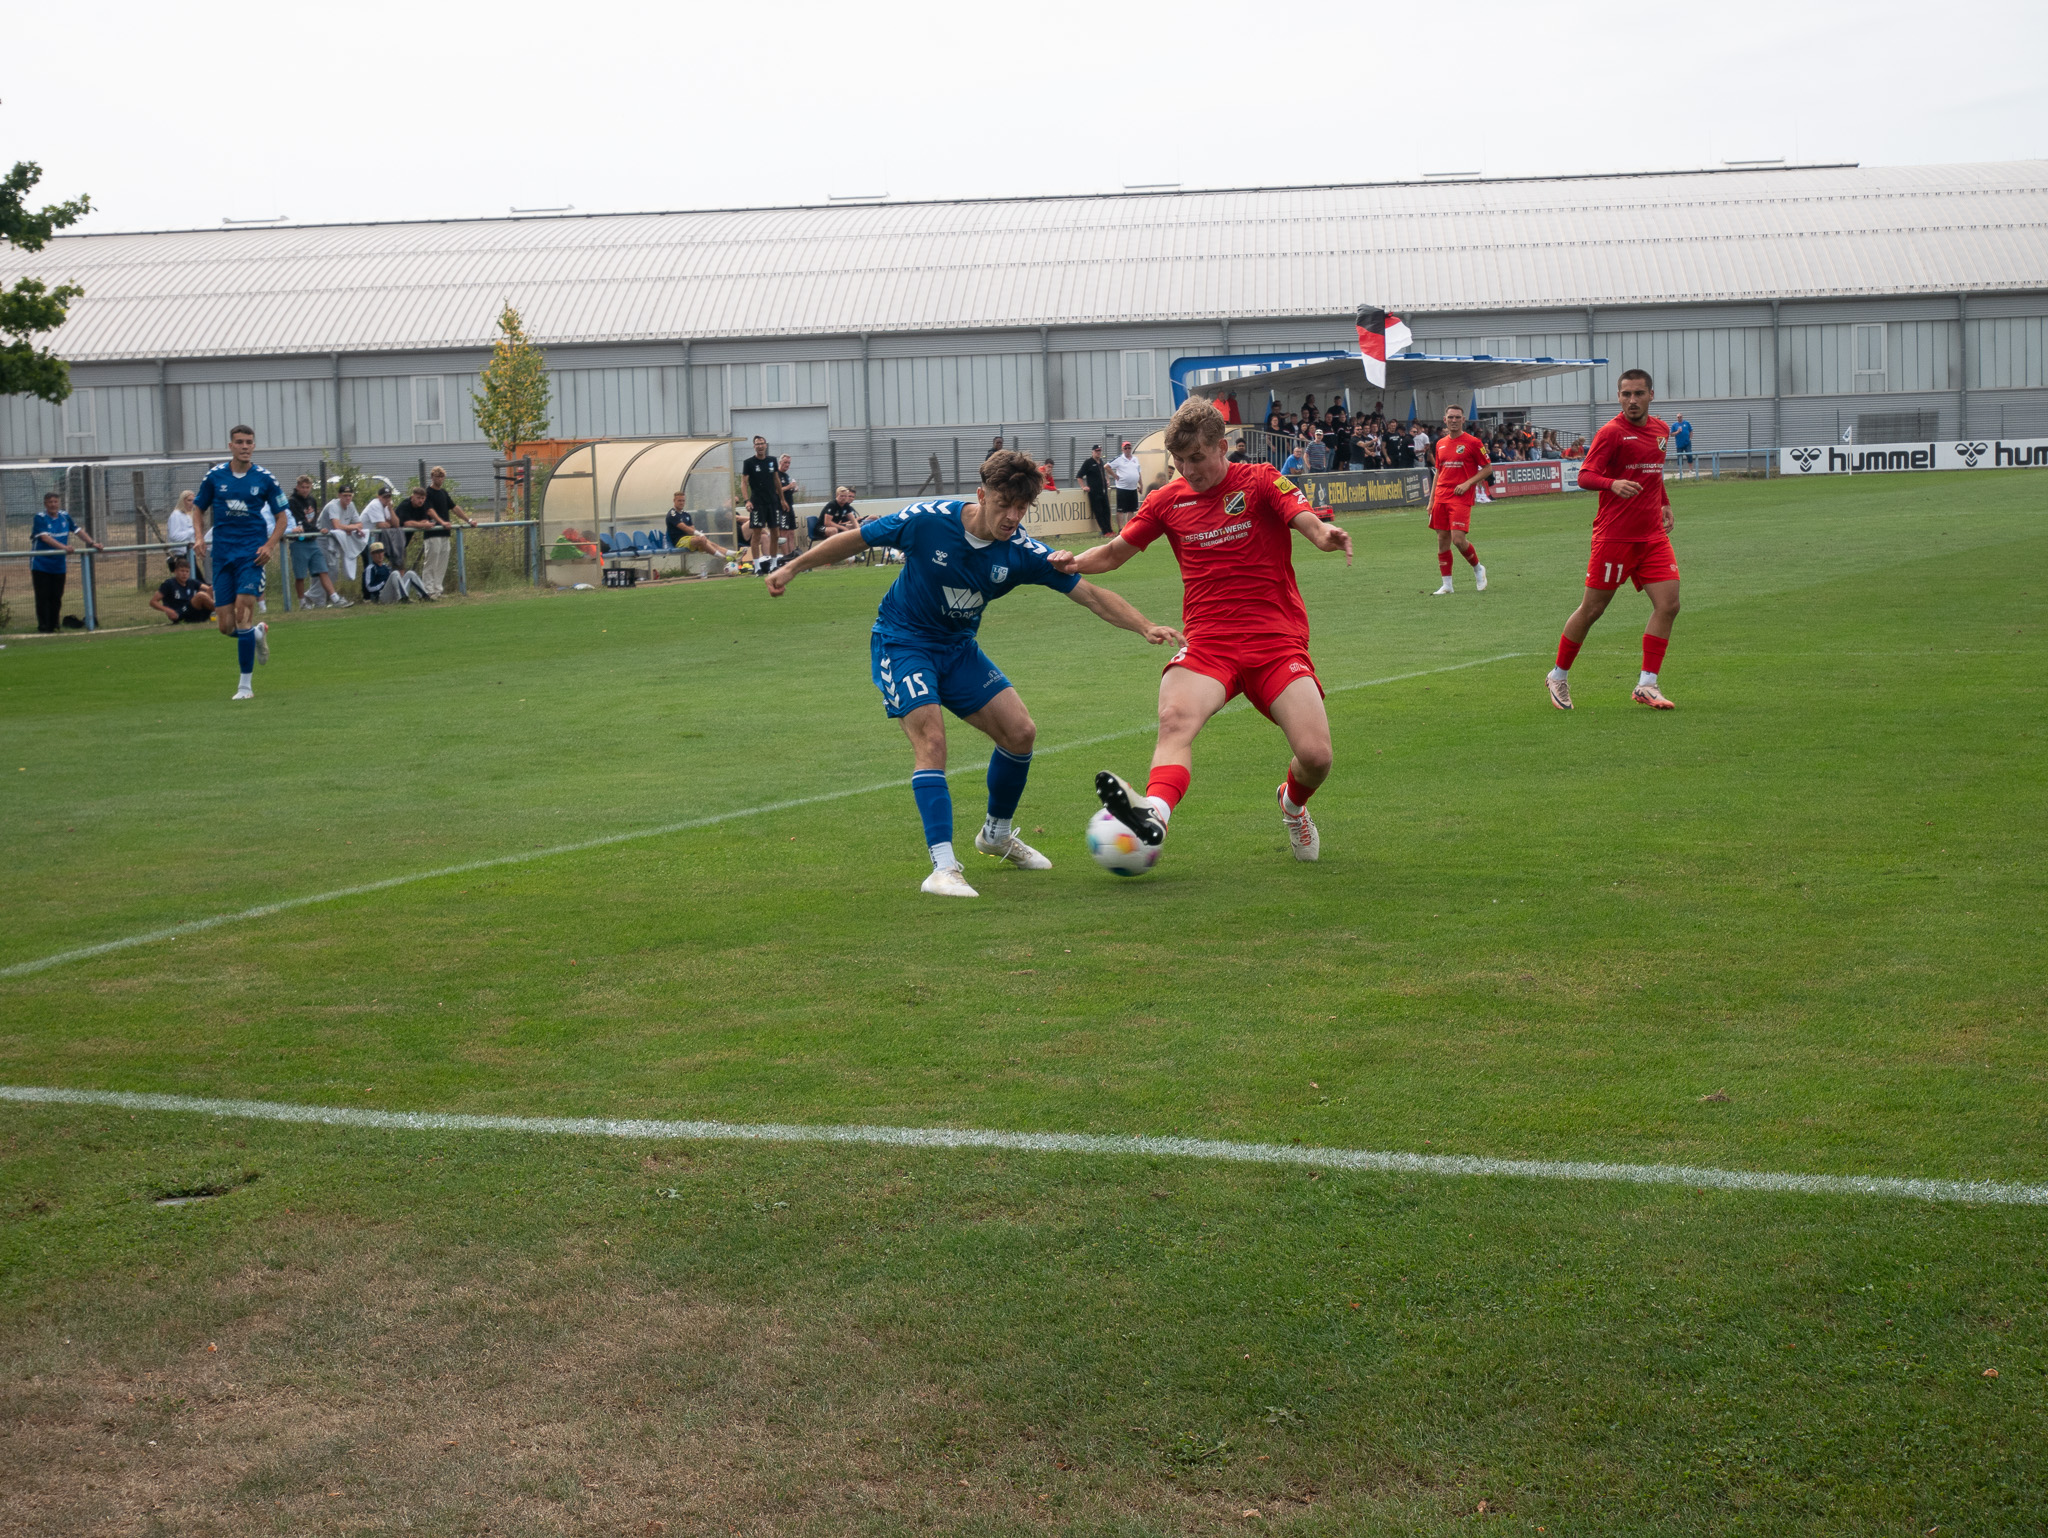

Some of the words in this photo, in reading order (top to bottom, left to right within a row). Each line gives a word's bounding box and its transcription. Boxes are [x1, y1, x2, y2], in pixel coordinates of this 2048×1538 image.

[1828, 443, 1936, 472] hummel
[1327, 481, 1348, 504] EDEKA
[1604, 562, 1624, 583] 11
[902, 672, 929, 699] 15
